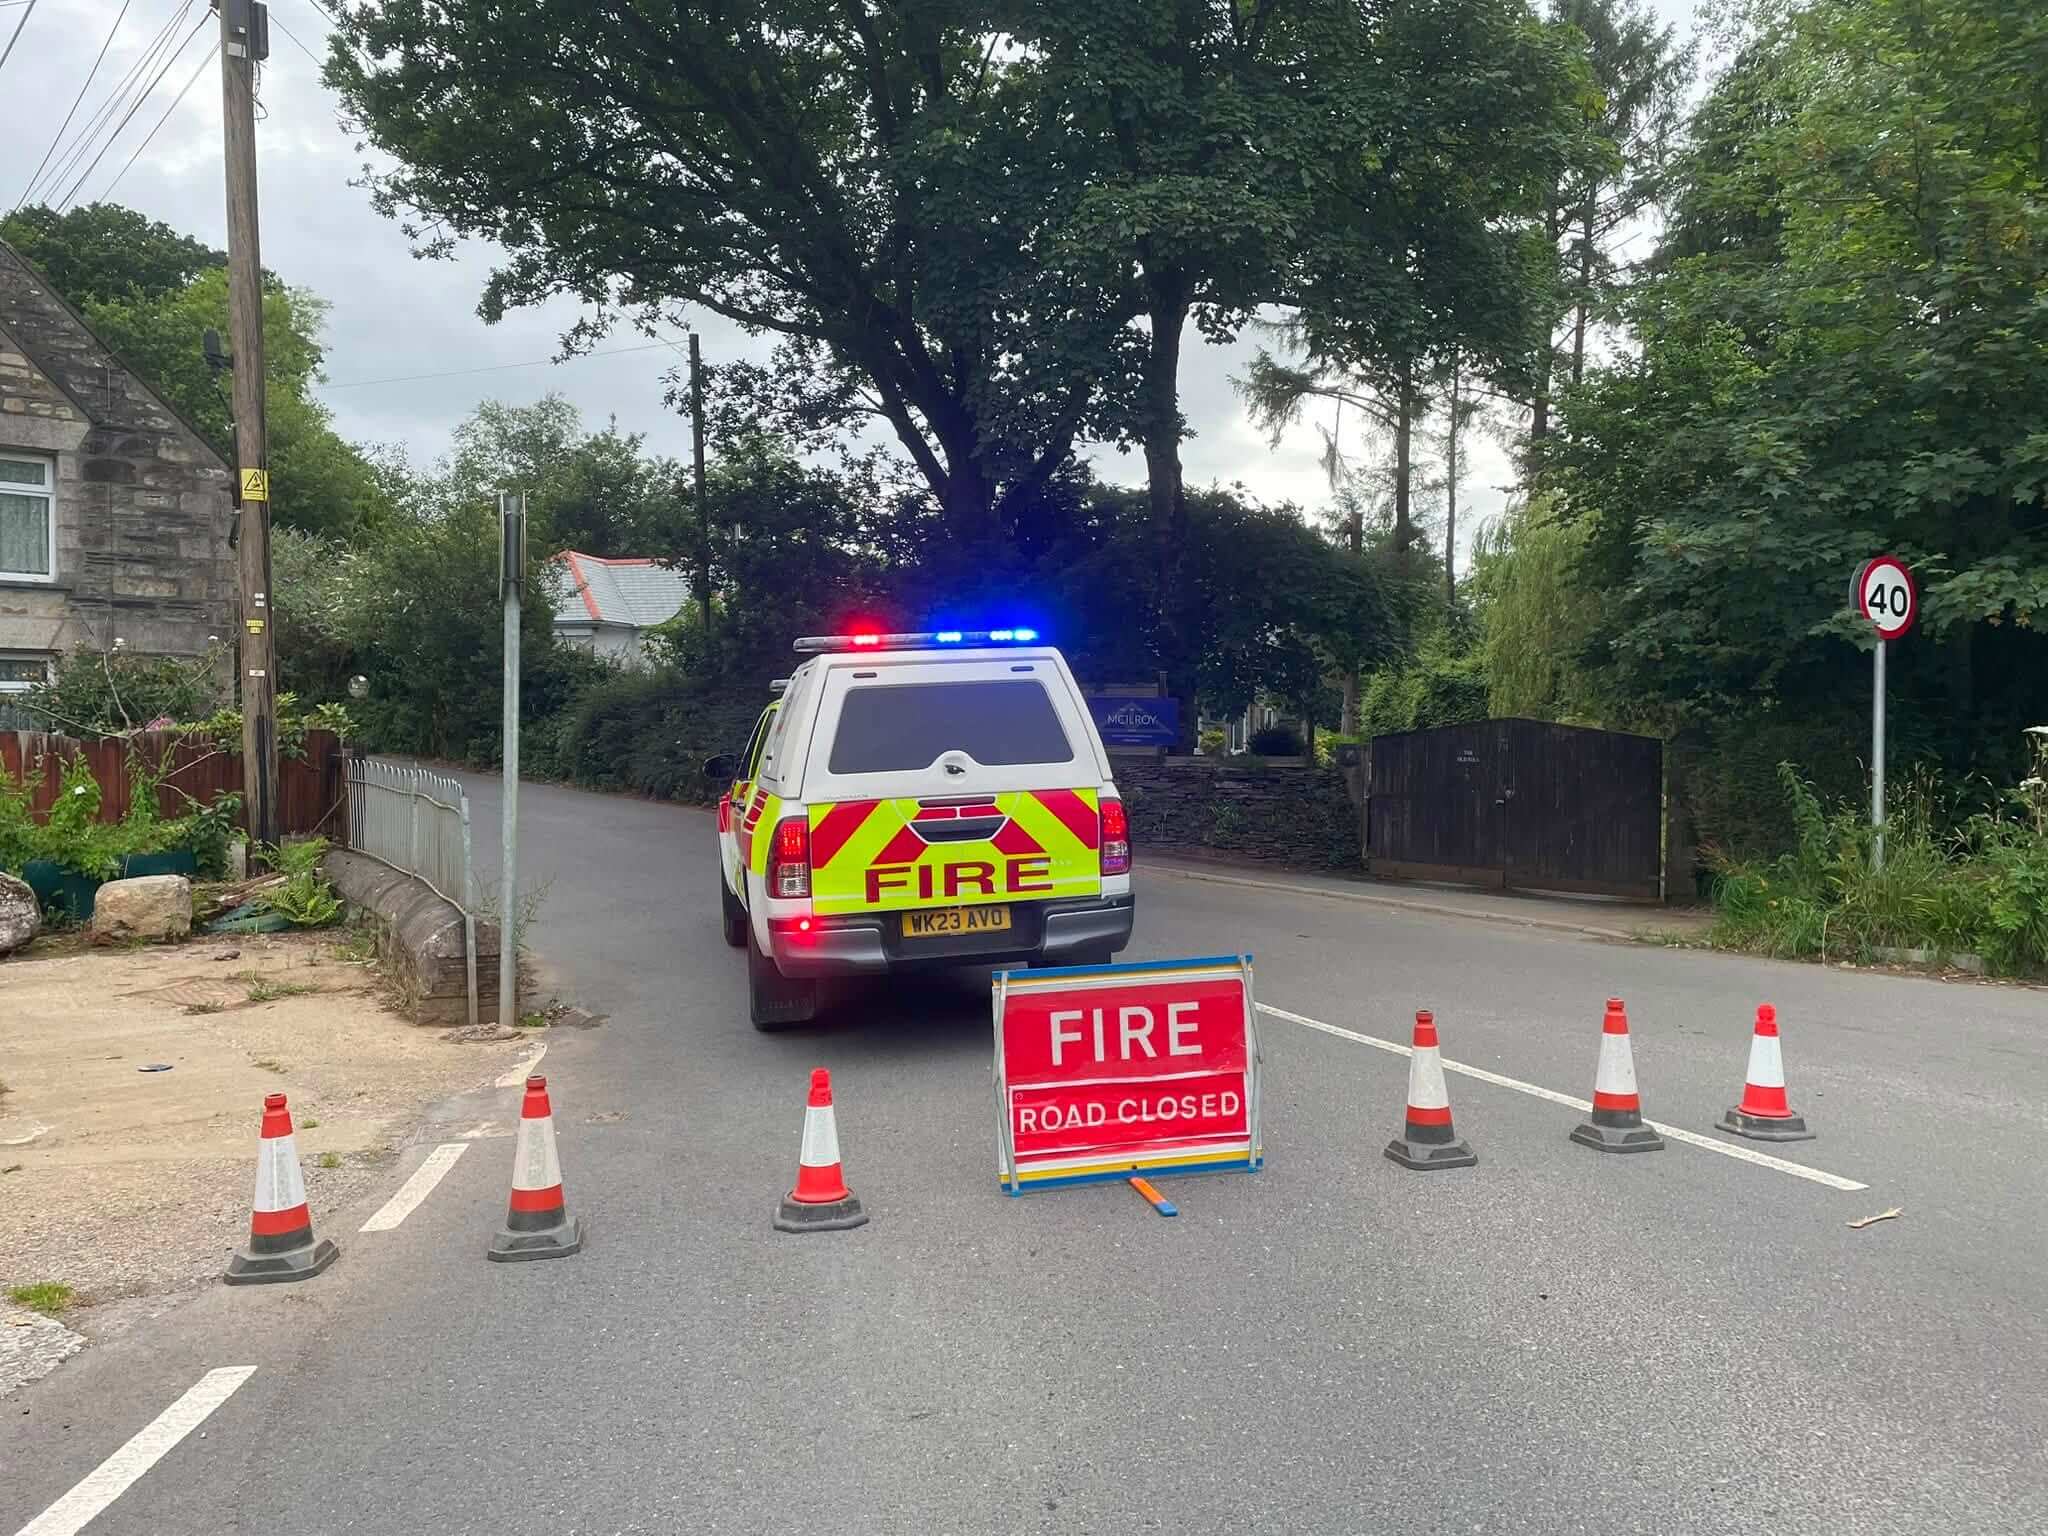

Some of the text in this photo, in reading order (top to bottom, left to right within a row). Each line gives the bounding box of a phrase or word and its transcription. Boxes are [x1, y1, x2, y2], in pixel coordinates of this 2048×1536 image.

[1868, 583, 1908, 618] 40
[1106, 714, 1158, 726] MCILROY
[865, 857, 1054, 903] FIRE
[911, 911, 961, 934] WK23
[1050, 1001, 1203, 1067] FIRE
[1019, 1091, 1241, 1133] ROAD CLOSED
